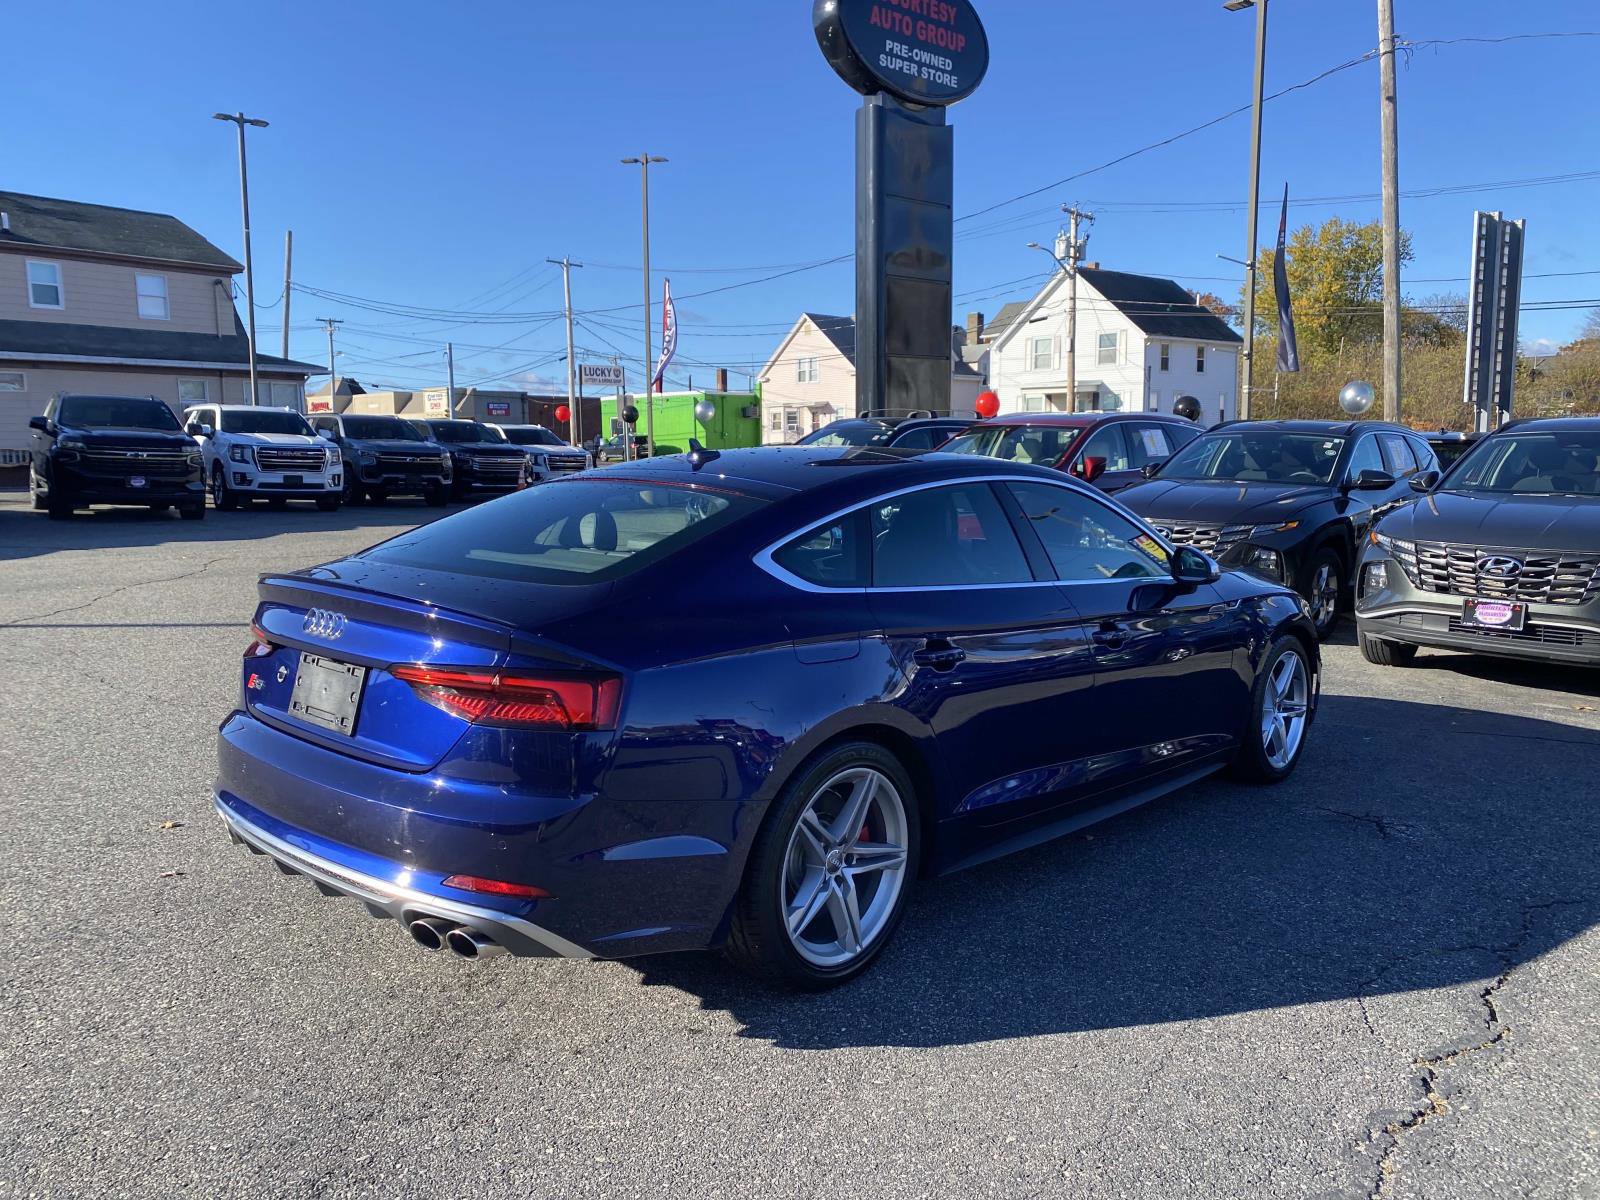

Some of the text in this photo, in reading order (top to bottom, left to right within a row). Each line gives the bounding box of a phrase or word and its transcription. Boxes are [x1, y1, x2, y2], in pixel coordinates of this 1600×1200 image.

[882, 0, 957, 25] RTESY
[870, 6, 966, 52] AUTO GROUP
[879, 54, 958, 88] SUPER STORE
[885, 40, 953, 71] PRE-OWNED
[583, 366, 612, 377] LUCKY
